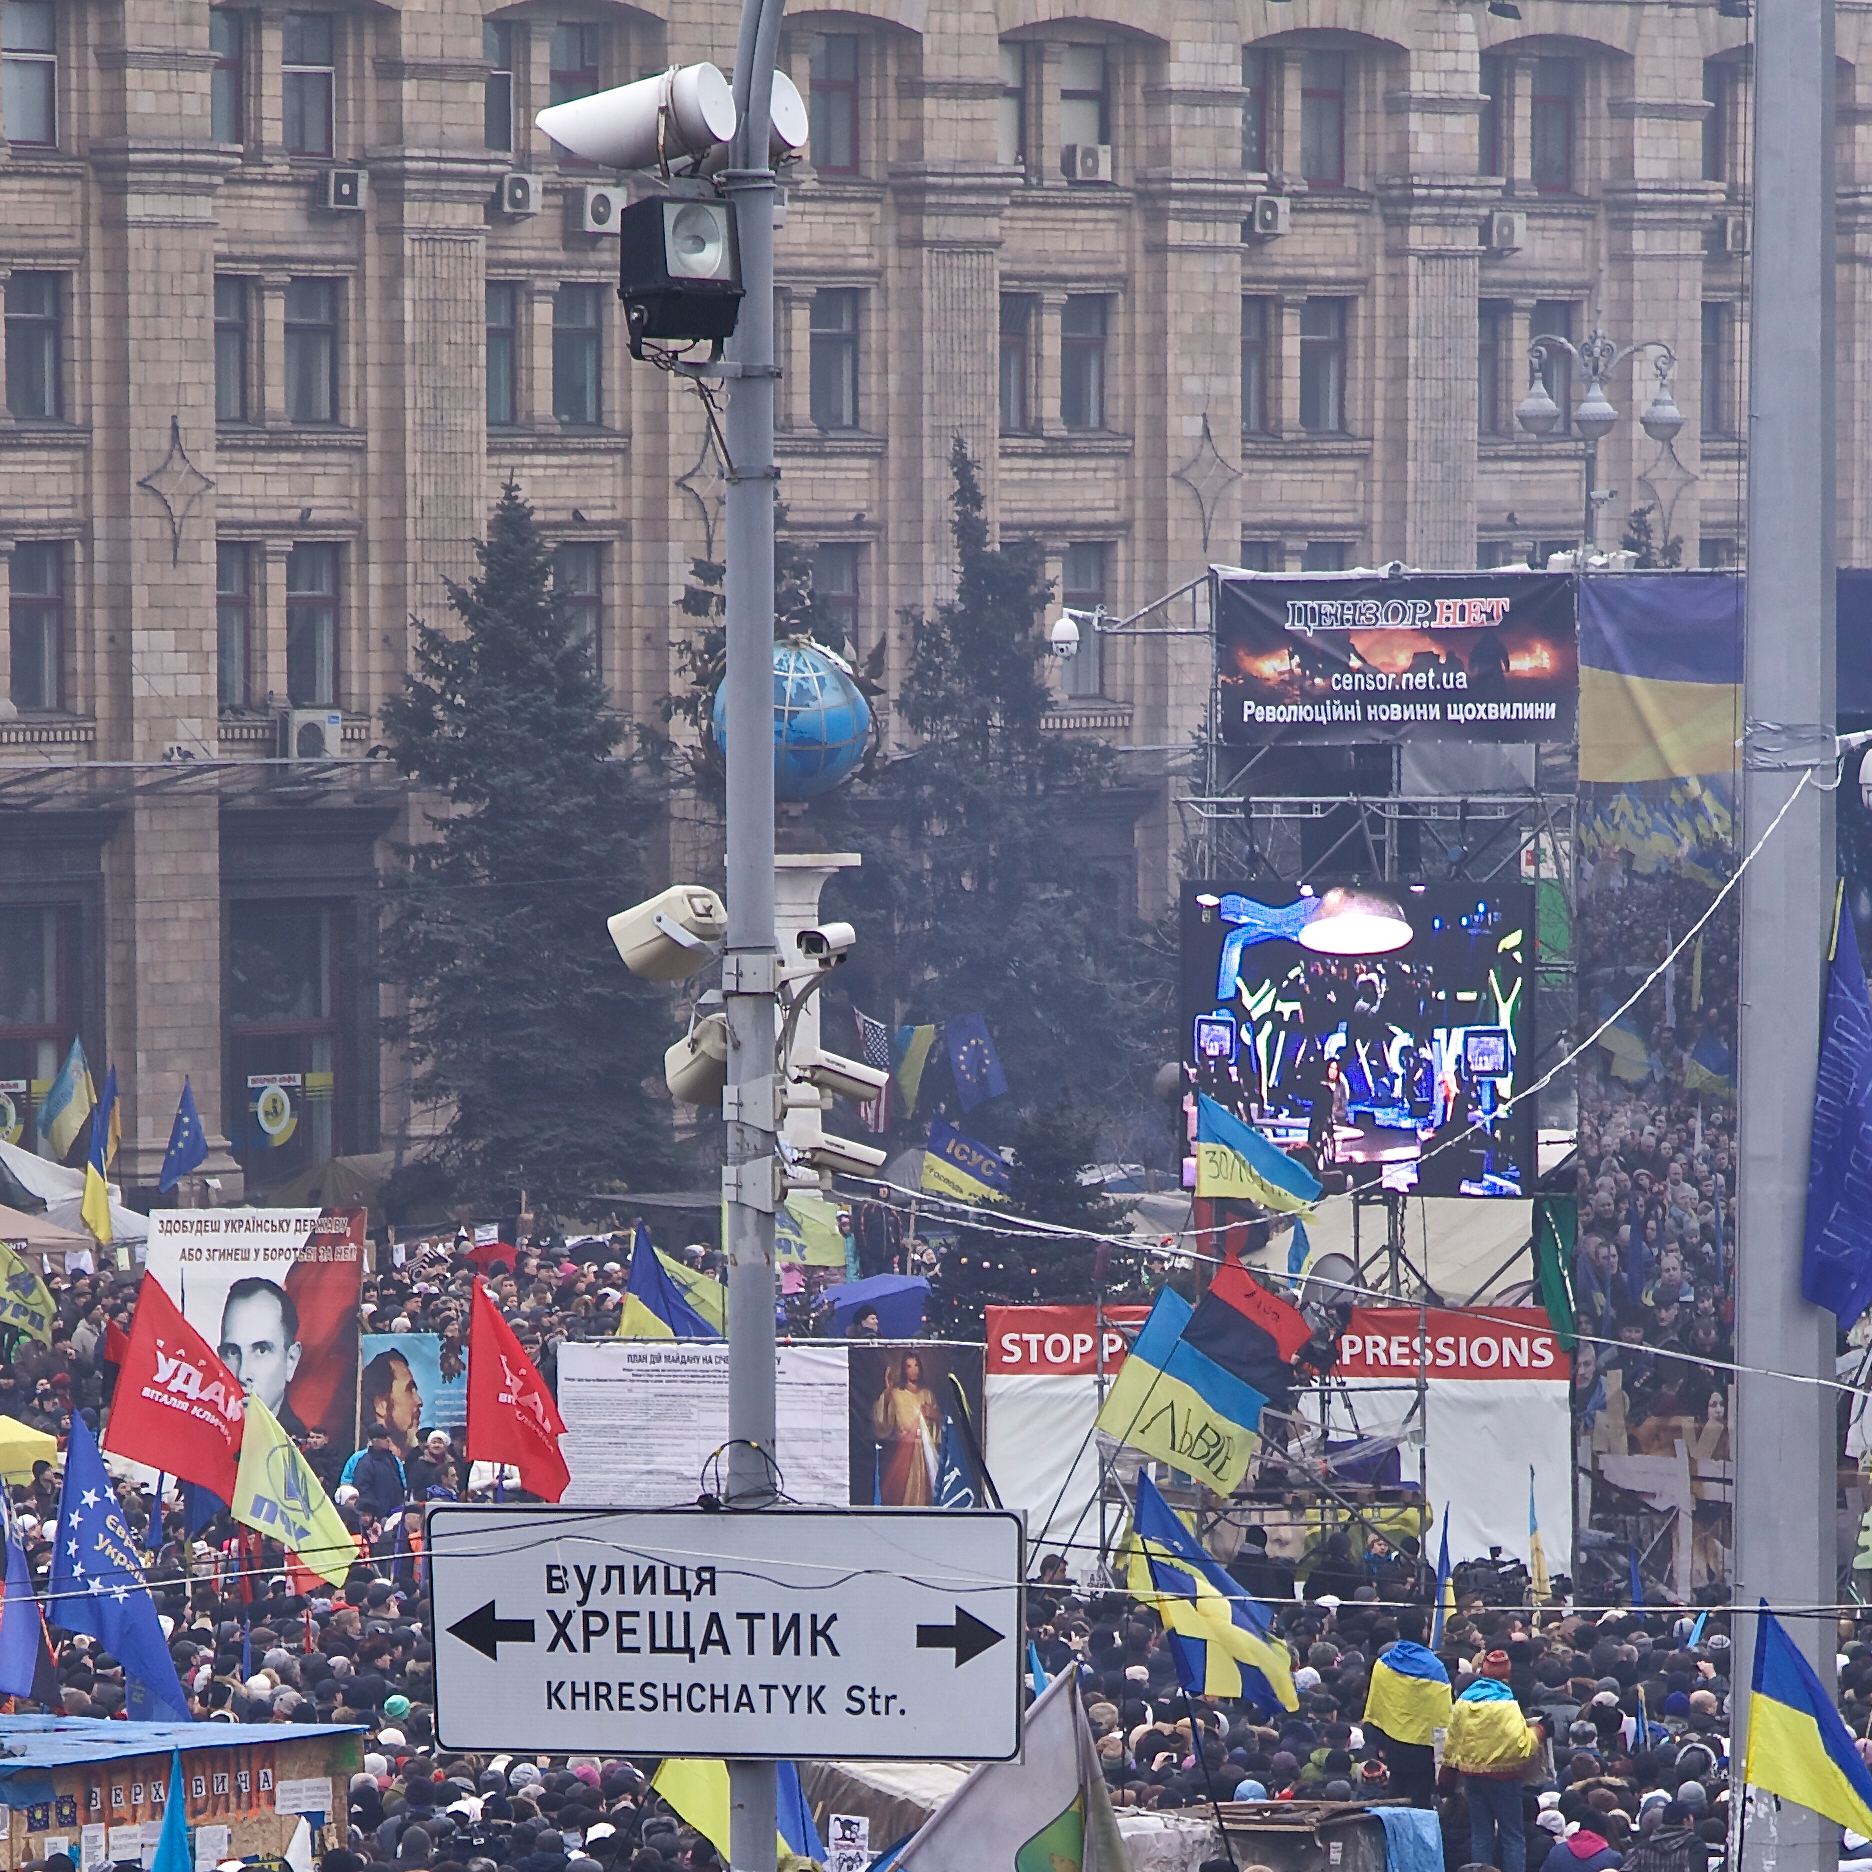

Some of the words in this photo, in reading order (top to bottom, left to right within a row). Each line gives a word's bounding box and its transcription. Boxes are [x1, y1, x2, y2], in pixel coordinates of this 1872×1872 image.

[1284, 598, 1510, 638] ЦЕНЗОР.НЕТ
[1331, 669, 1468, 692] censor.net.ua
[1243, 700, 1361, 725] Революційні
[1367, 704, 1440, 722] новини
[1447, 702, 1555, 724] щохвилини
[946, 1138, 996, 1177] ІСУС
[158, 1219, 221, 1236] ЗДОБУДЕШ
[223, 1216, 291, 1233] УКРАЇНСЬКУ
[294, 1217, 351, 1238] ДЕРЖАВУ,
[179, 1248, 203, 1261] АБО
[205, 1248, 250, 1261] ЗГИНЕШ
[262, 1247, 316, 1262] БОРОТЬБІ
[319, 1246, 333, 1262] ЗА
[626, 1354, 648, 1365] ПЛАН
[1001, 1333, 1093, 1364] STOP
[1340, 1335, 1555, 1368] PRESSIONS
[545, 1611, 842, 1663] ХРЕЩАТИК
[545, 1681, 827, 1714] KHRESHCHATYK
[845, 1686, 906, 1716] Str.
[90, 1771, 272, 1809] ВЕРХВИНА
